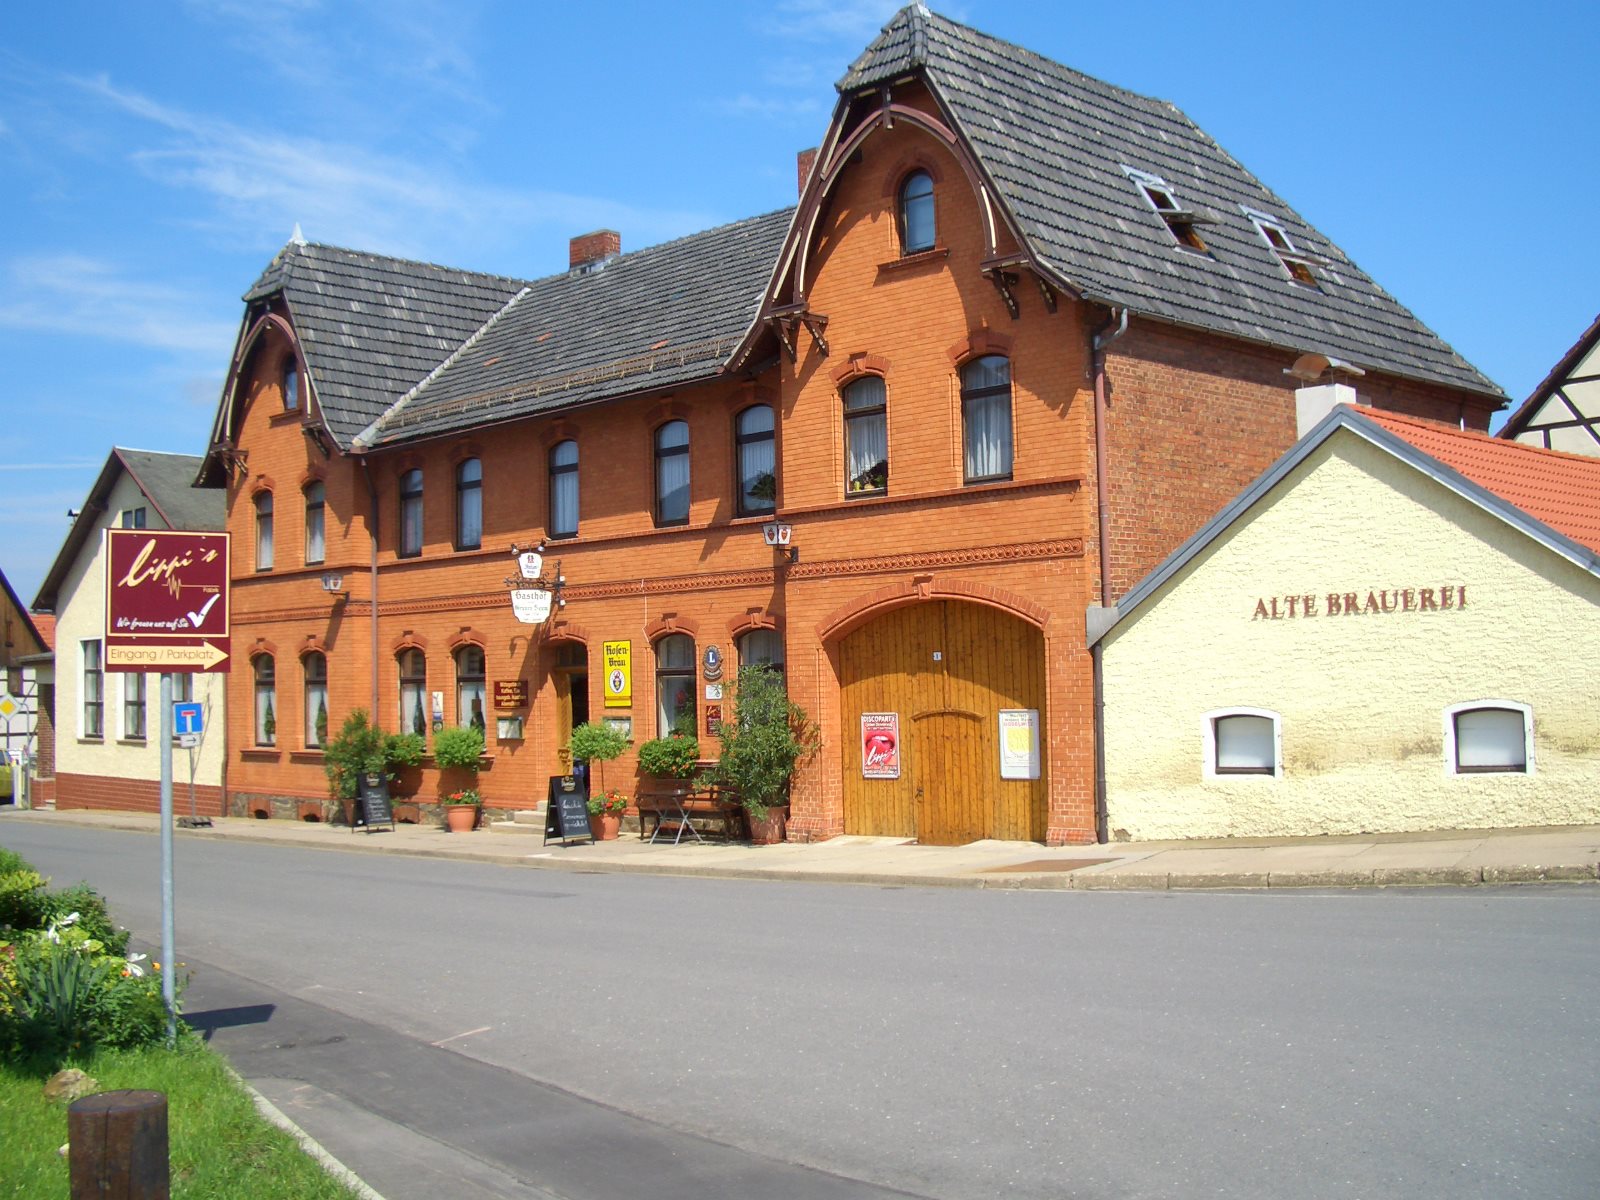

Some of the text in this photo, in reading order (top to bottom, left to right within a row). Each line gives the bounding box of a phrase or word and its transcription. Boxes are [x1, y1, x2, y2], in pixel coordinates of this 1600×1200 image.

[515, 590, 547, 600] Gasthof
[1251, 585, 1466, 621] ALTE BRAUEREI
[117, 617, 130, 627] Wir
[111, 649, 157, 661] Eingang
[167, 649, 214, 660] Parkplatz
[709, 652, 716, 663] L
